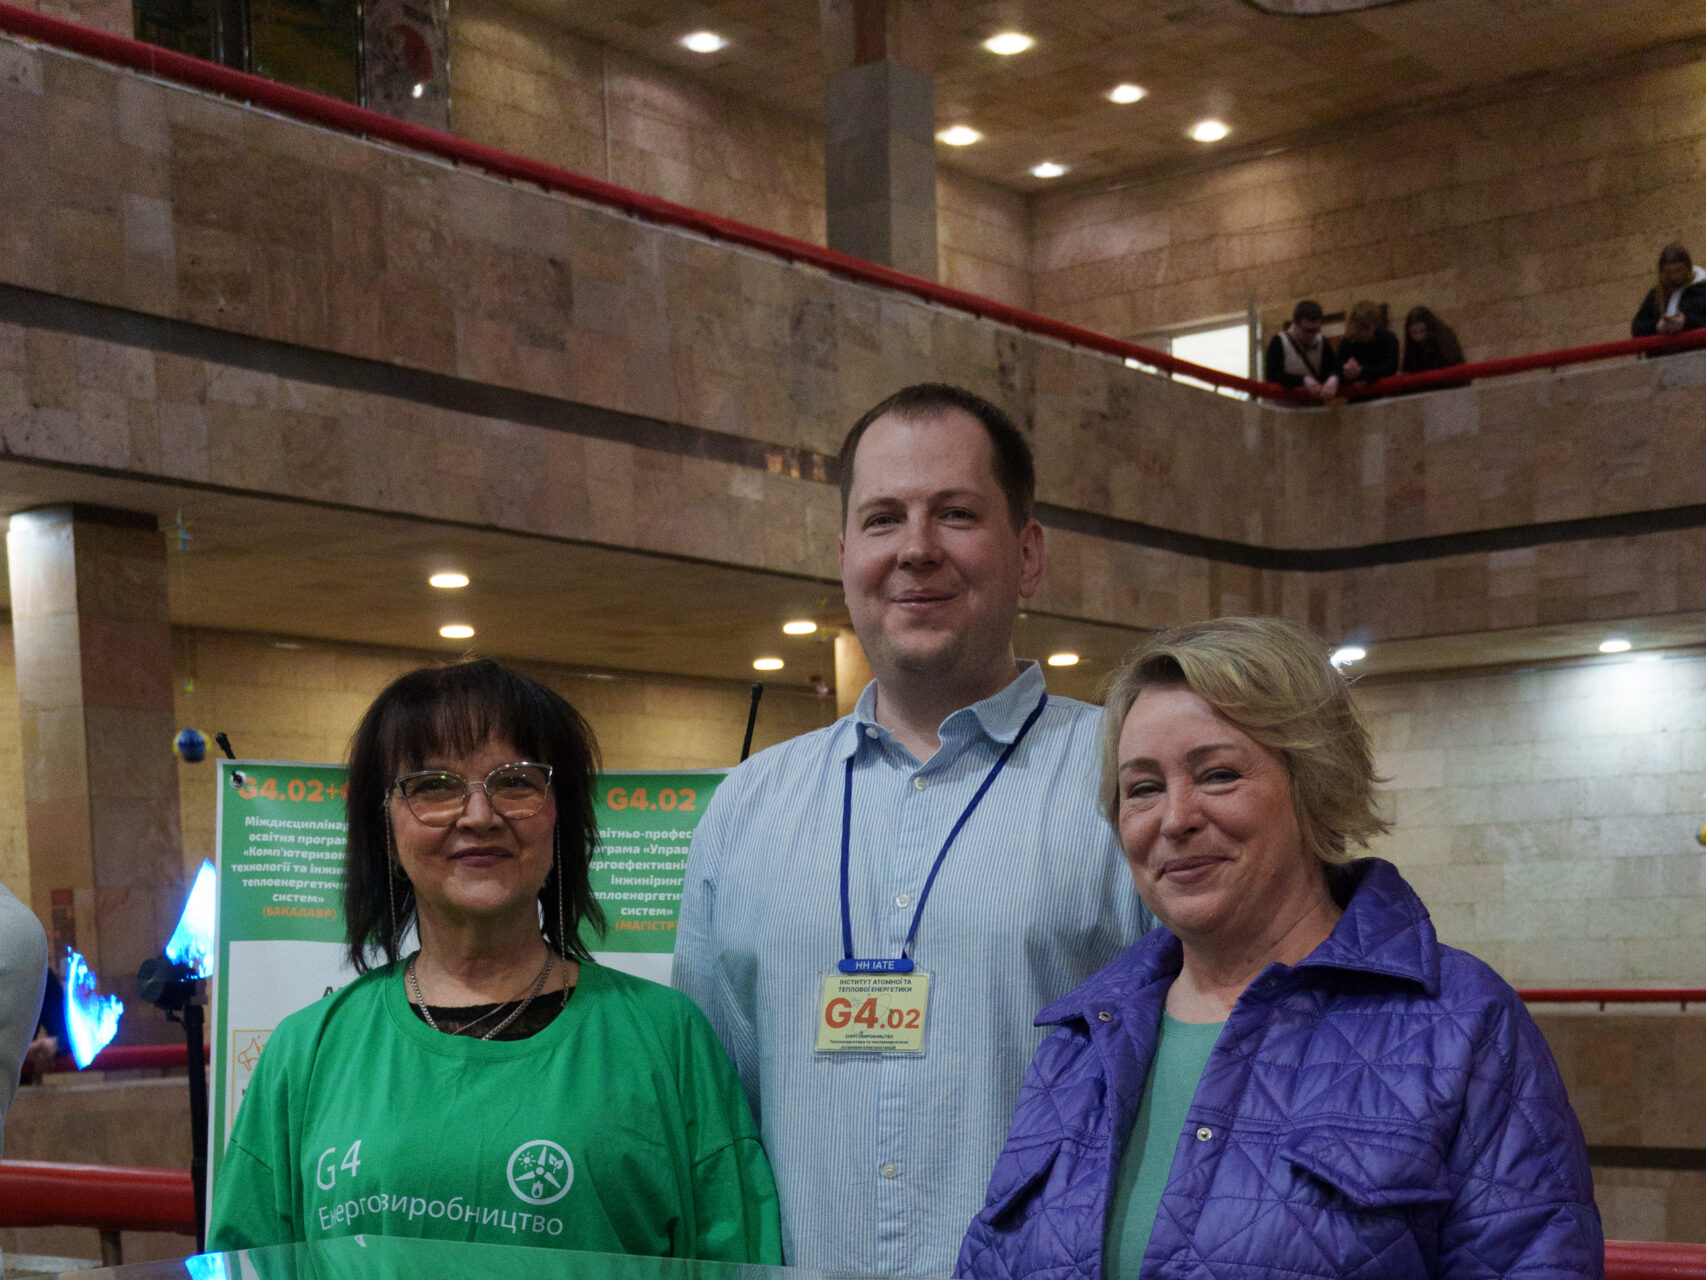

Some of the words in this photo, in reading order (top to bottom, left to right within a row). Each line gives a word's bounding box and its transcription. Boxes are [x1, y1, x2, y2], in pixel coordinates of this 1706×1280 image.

[606, 787, 697, 812] G4.02
[249, 832, 295, 843] освітня
[597, 828, 696, 841] вітньо-професі
[231, 861, 291, 873] технології
[293, 864, 308, 873] та
[611, 874, 685, 888] інжиніринг
[272, 893, 325, 904] систем»
[588, 891, 684, 903] еплоенергети
[262, 906, 337, 920] (БАКАЛАВР)
[621, 907, 673, 916] систем»
[873, 978, 903, 986] АТОМНОЇ
[838, 985, 870, 993] ТЕПЛОВОЇ
[825, 997, 921, 1029] G4.02
[316, 1139, 362, 1190] G4
